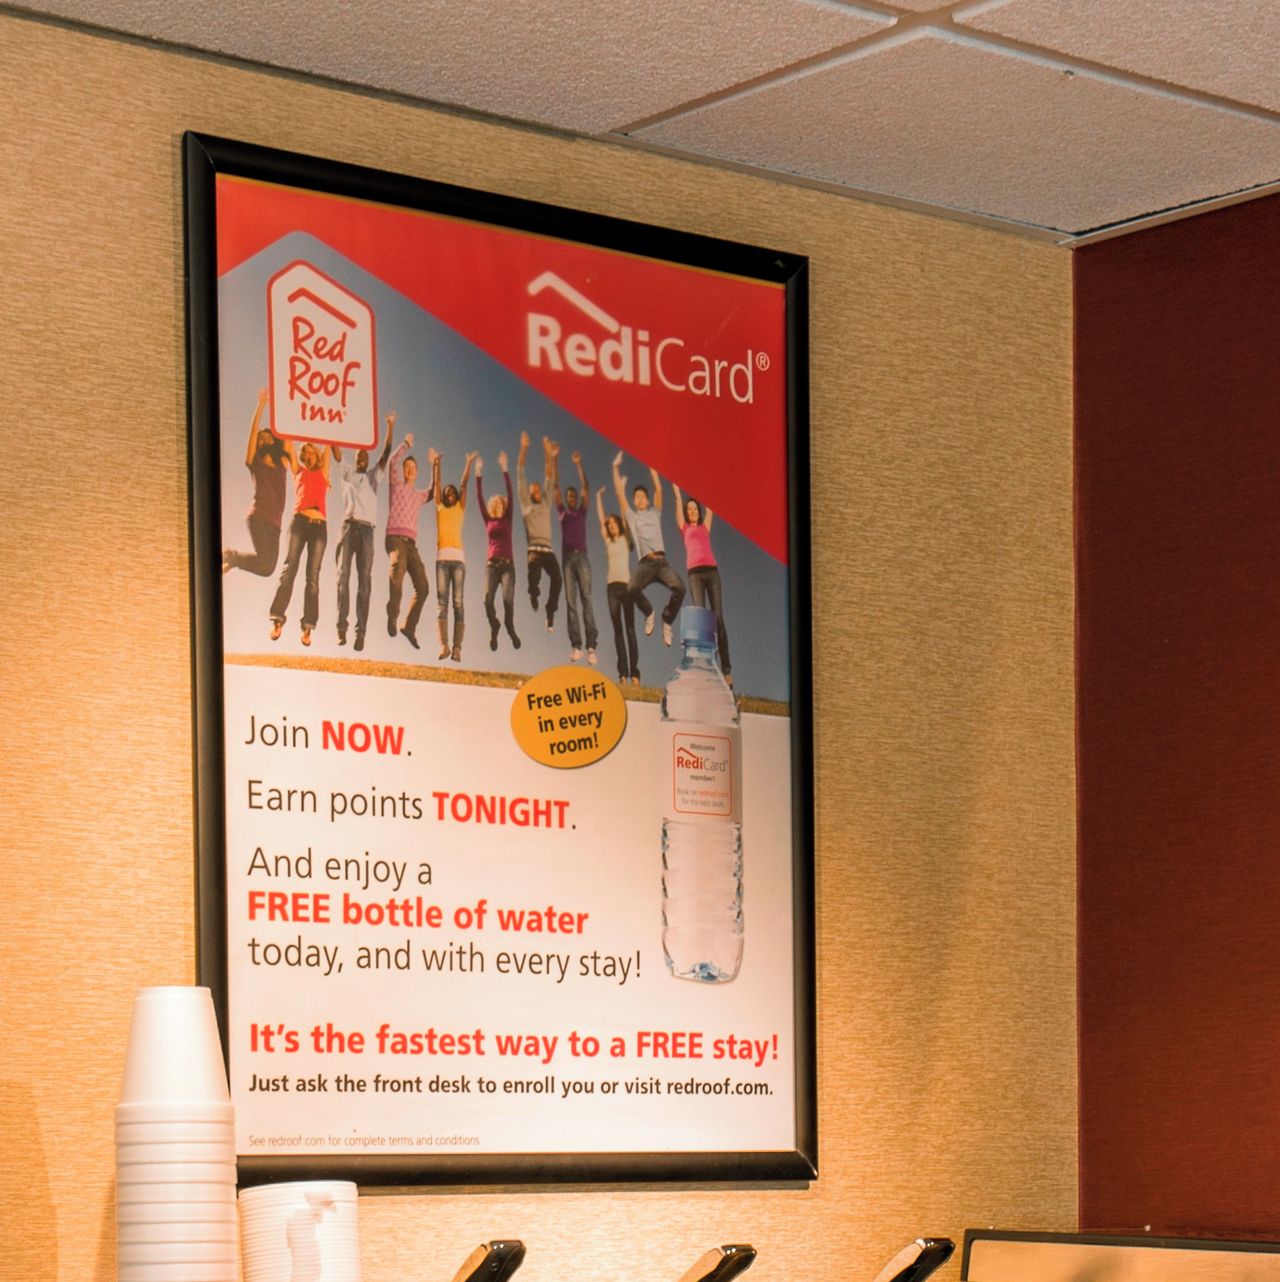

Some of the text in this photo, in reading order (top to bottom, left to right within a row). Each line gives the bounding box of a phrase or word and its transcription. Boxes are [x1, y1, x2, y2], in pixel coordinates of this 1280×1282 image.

[292, 316, 347, 362] Red
[288, 355, 361, 408] Roof
[527, 682, 607, 710] Free Wi-Fi
[245, 715, 412, 756] Join NOW.
[538, 711, 603, 733] in every
[549, 732, 599, 755] room!
[248, 780, 576, 829] Earn points TONIGHT.
[247, 847, 432, 891] And enjoy a
[248, 890, 589, 934] FREE bottle of water
[248, 935, 642, 985] today, and with every stay!
[250, 1023, 778, 1067] It’s the fastest way to a FREE stay!
[249, 1074, 773, 1098] Just ask the front desk to enroll you or visit redroof.com.
[249, 1134, 480, 1149] See redroof.com for complete terms and conditions
